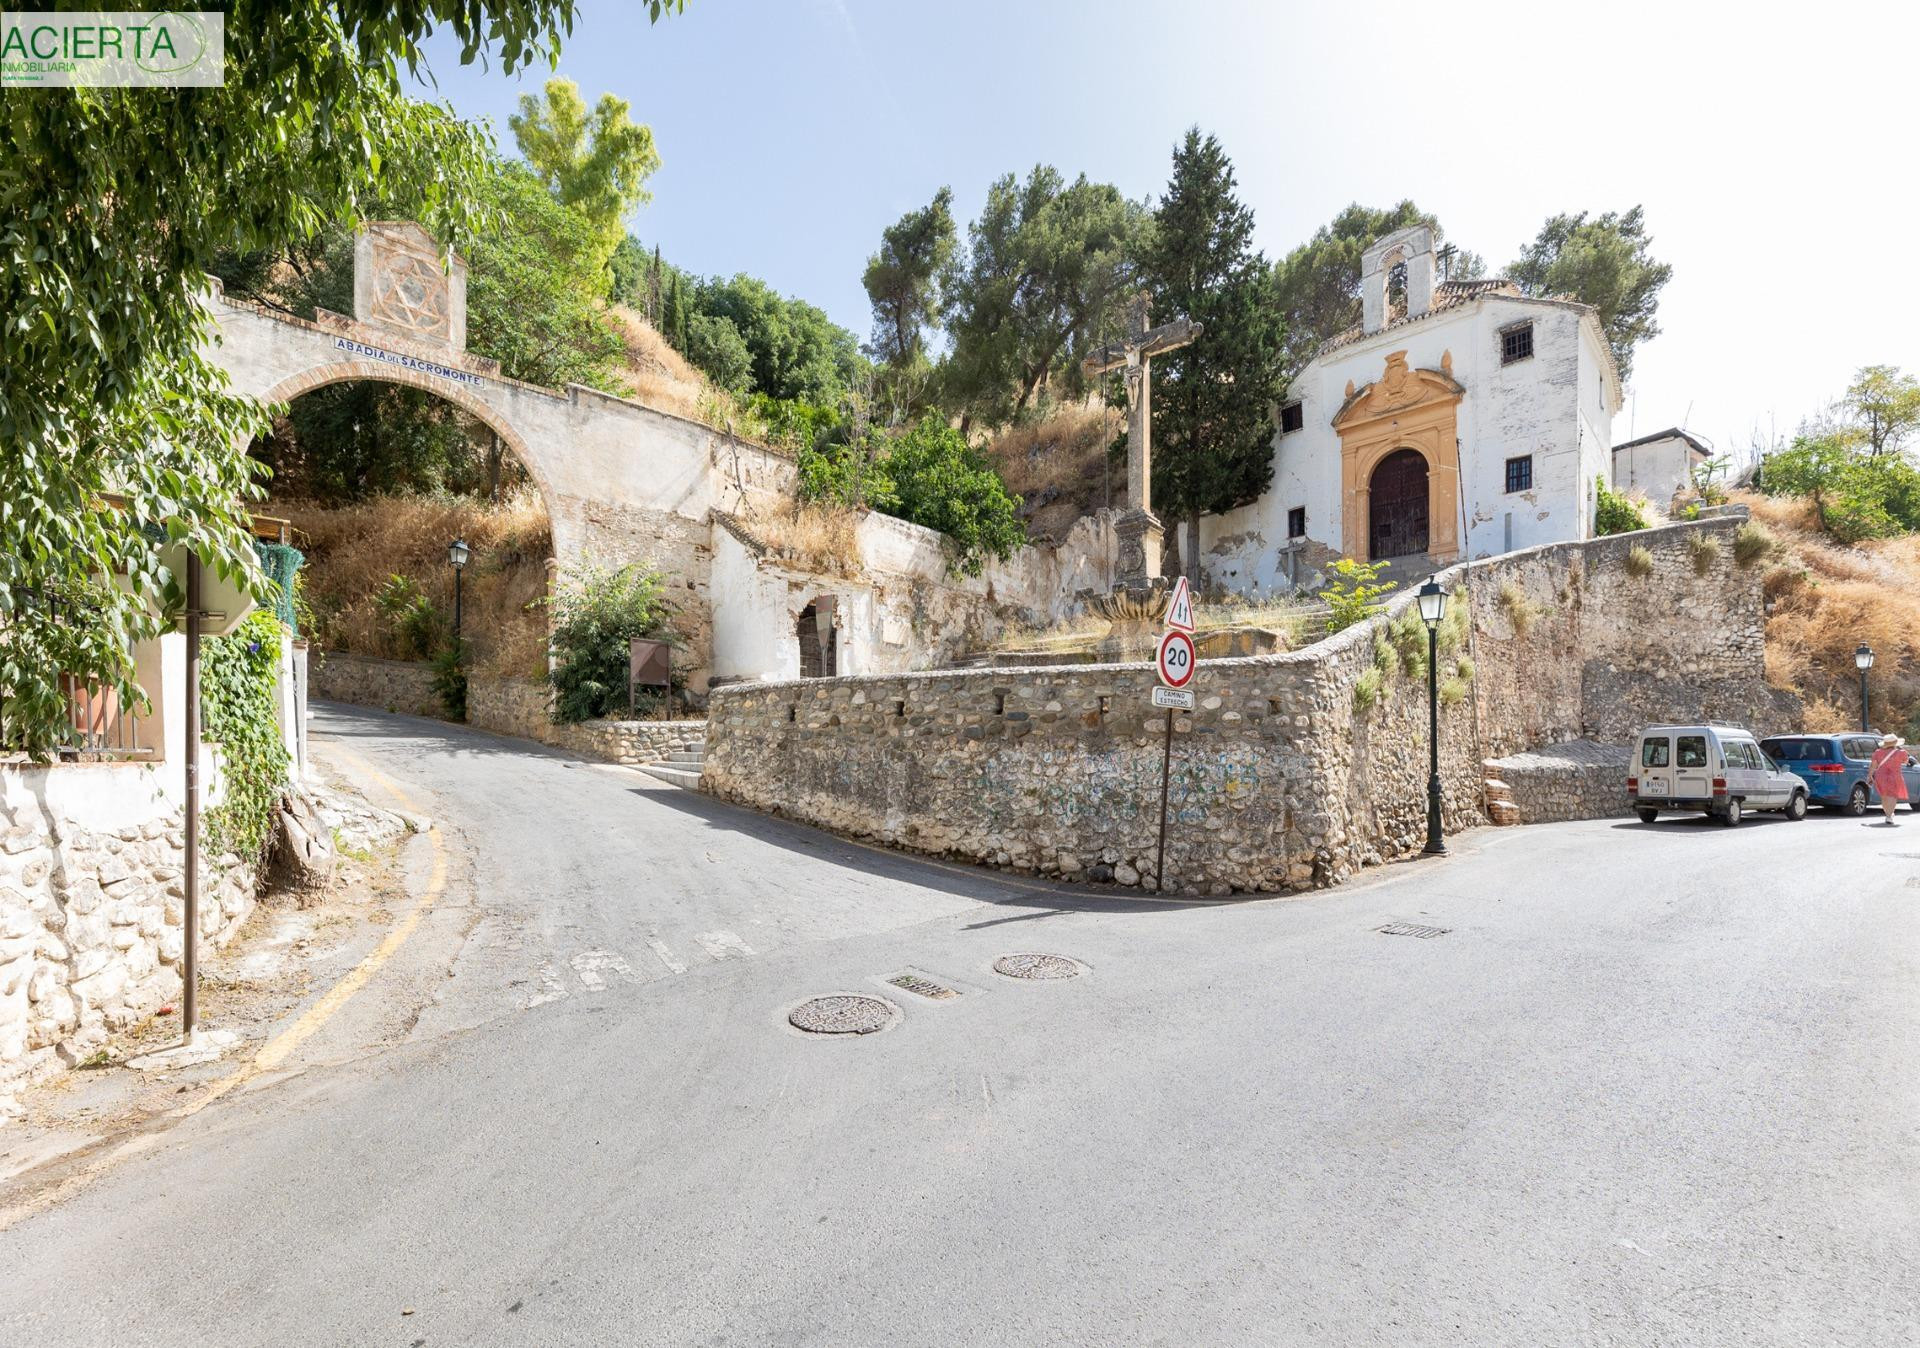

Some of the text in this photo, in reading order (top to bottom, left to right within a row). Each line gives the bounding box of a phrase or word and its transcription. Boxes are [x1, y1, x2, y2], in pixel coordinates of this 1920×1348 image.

[387, 354, 400, 365] DEL
[401, 356, 481, 386] SACROMONTE
[1168, 647, 1187, 667] 20
[1160, 696, 1189, 706] ESTRECHO
[1163, 690, 1186, 699] CAMINO
